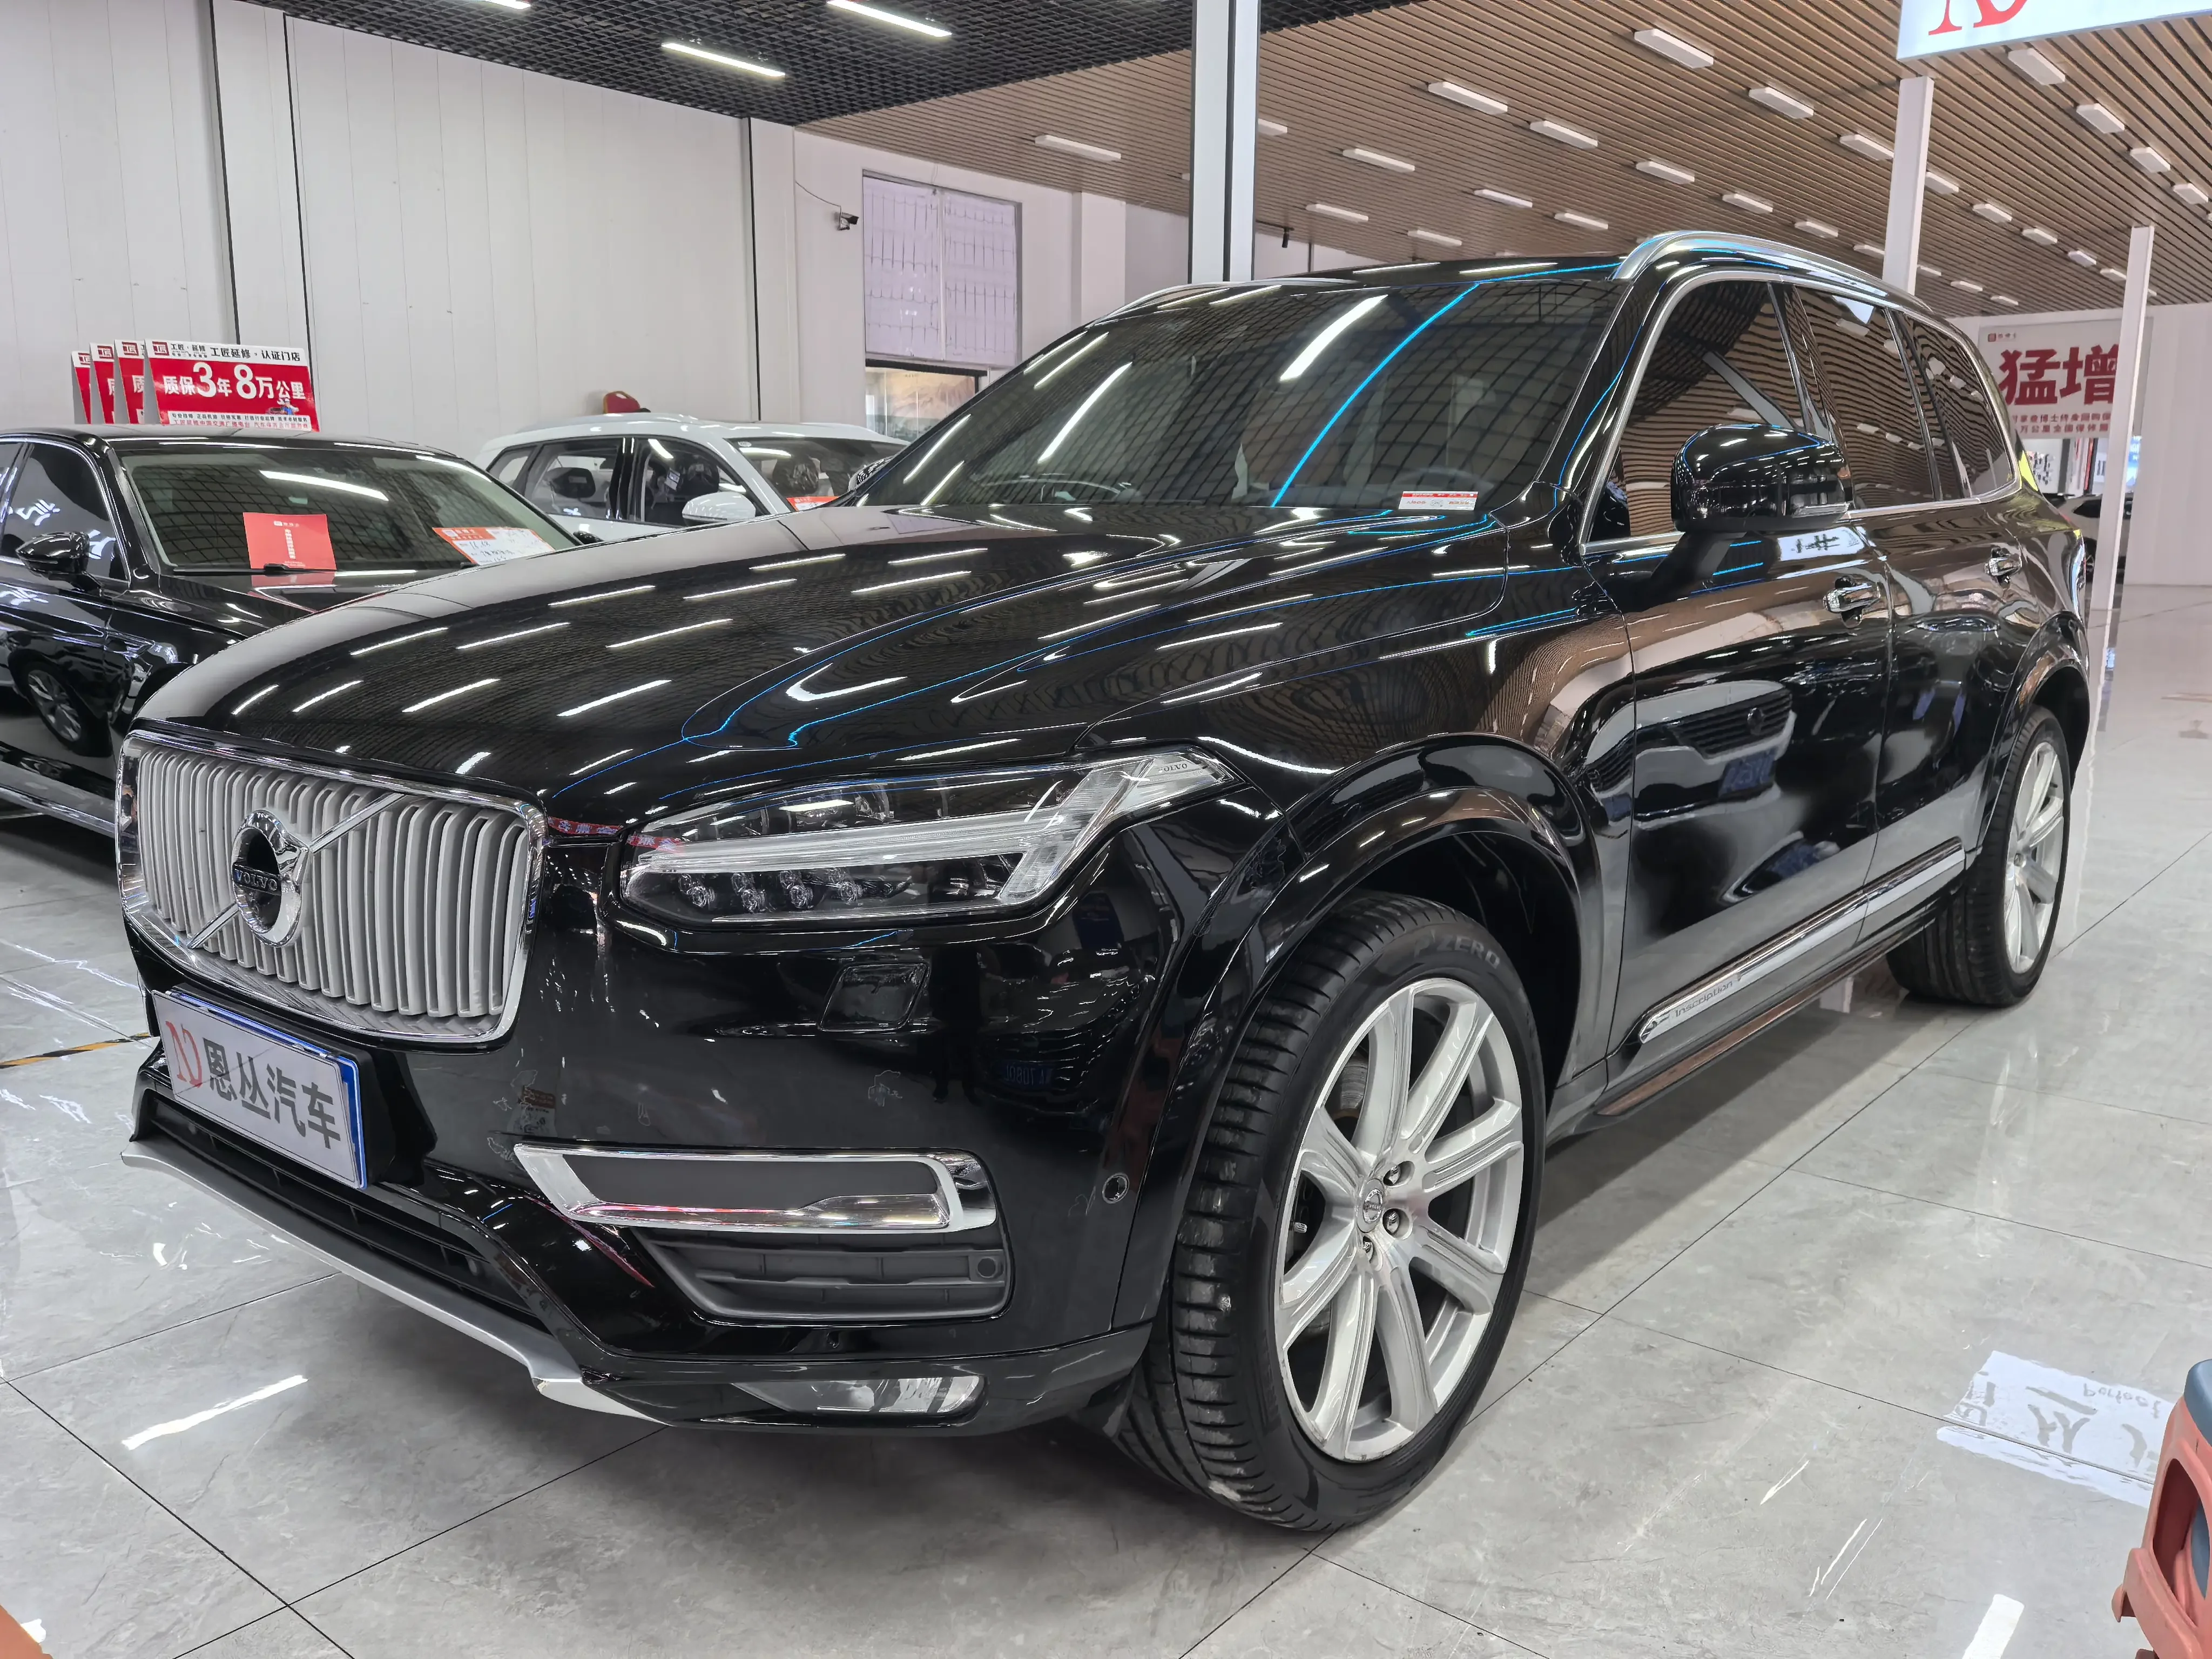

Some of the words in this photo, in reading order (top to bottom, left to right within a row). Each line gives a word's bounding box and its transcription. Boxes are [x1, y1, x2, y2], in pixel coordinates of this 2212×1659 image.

[1998, 344, 2119, 405] 猛增
[234, 868, 278, 891] VOLVO
[1435, 936, 1501, 969] ZERO
[1675, 980, 1733, 1017] Inscription
[203, 1037, 341, 1149] 恩丛汽车
